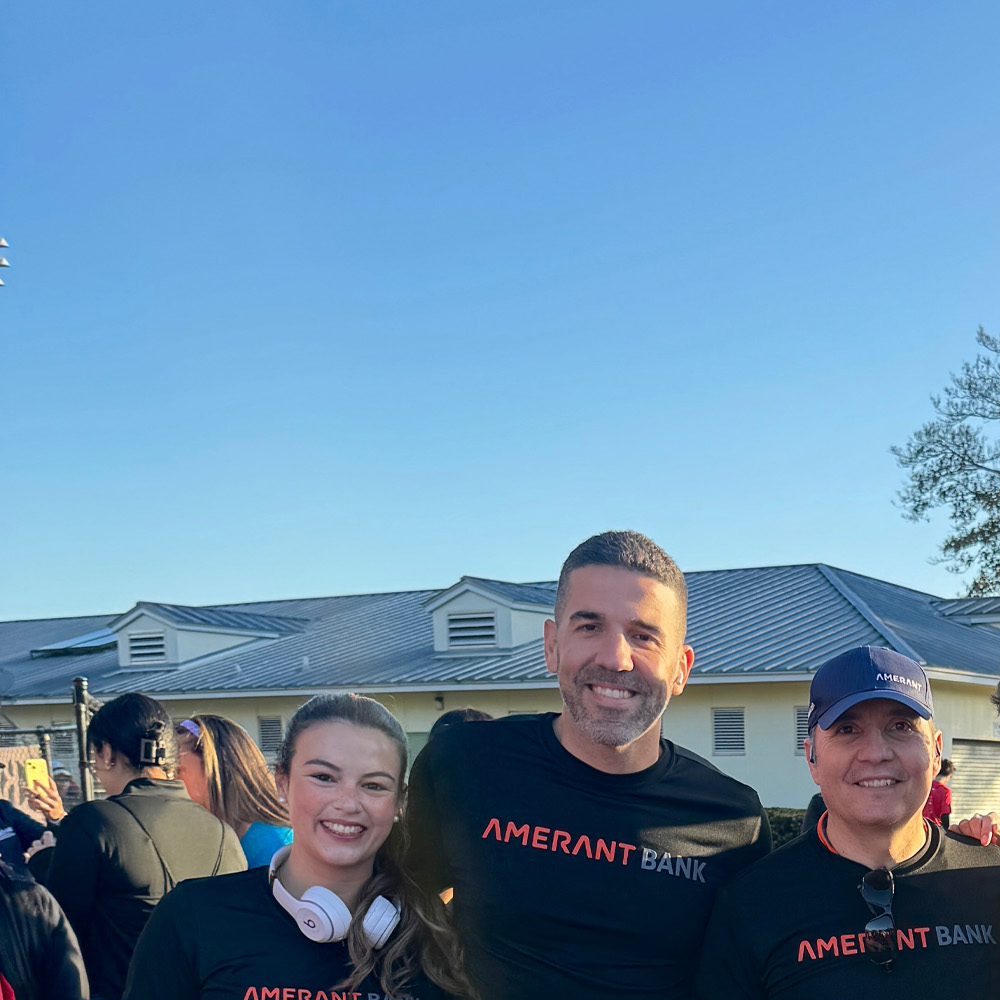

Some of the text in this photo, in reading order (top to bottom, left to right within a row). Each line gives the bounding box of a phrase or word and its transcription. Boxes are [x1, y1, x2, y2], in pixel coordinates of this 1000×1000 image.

[876, 673, 922, 692] AMERANT
[482, 818, 706, 883] AMERANT BANK
[798, 924, 997, 962] AMENT BANK
